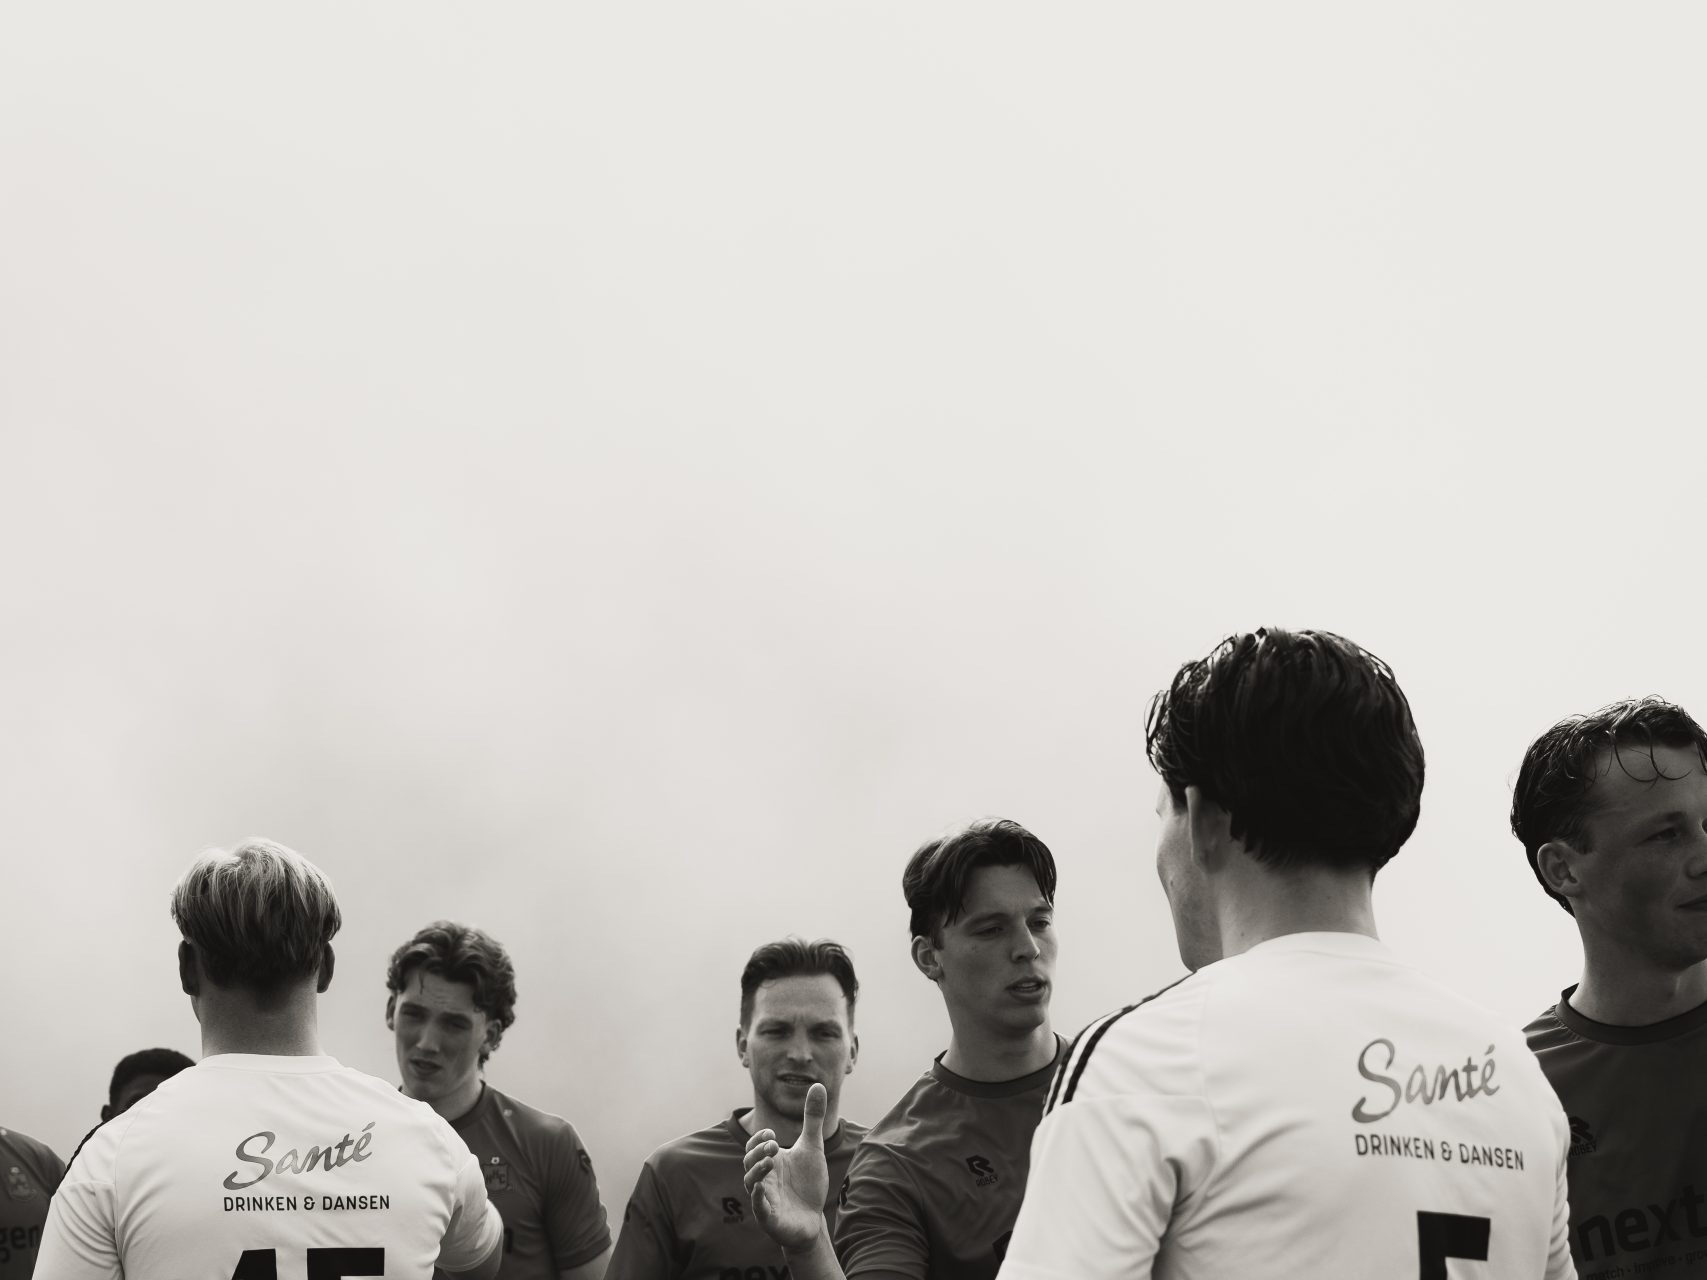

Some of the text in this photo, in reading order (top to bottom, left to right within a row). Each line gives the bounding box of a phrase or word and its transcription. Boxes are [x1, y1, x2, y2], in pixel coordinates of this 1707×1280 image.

[1352, 1038, 1500, 1124] Santé
[222, 1121, 376, 1190] Santé
[1355, 1134, 1524, 1170] DRINKEN & DANSEN
[224, 1194, 390, 1212] DRINKEN & DANSEN
